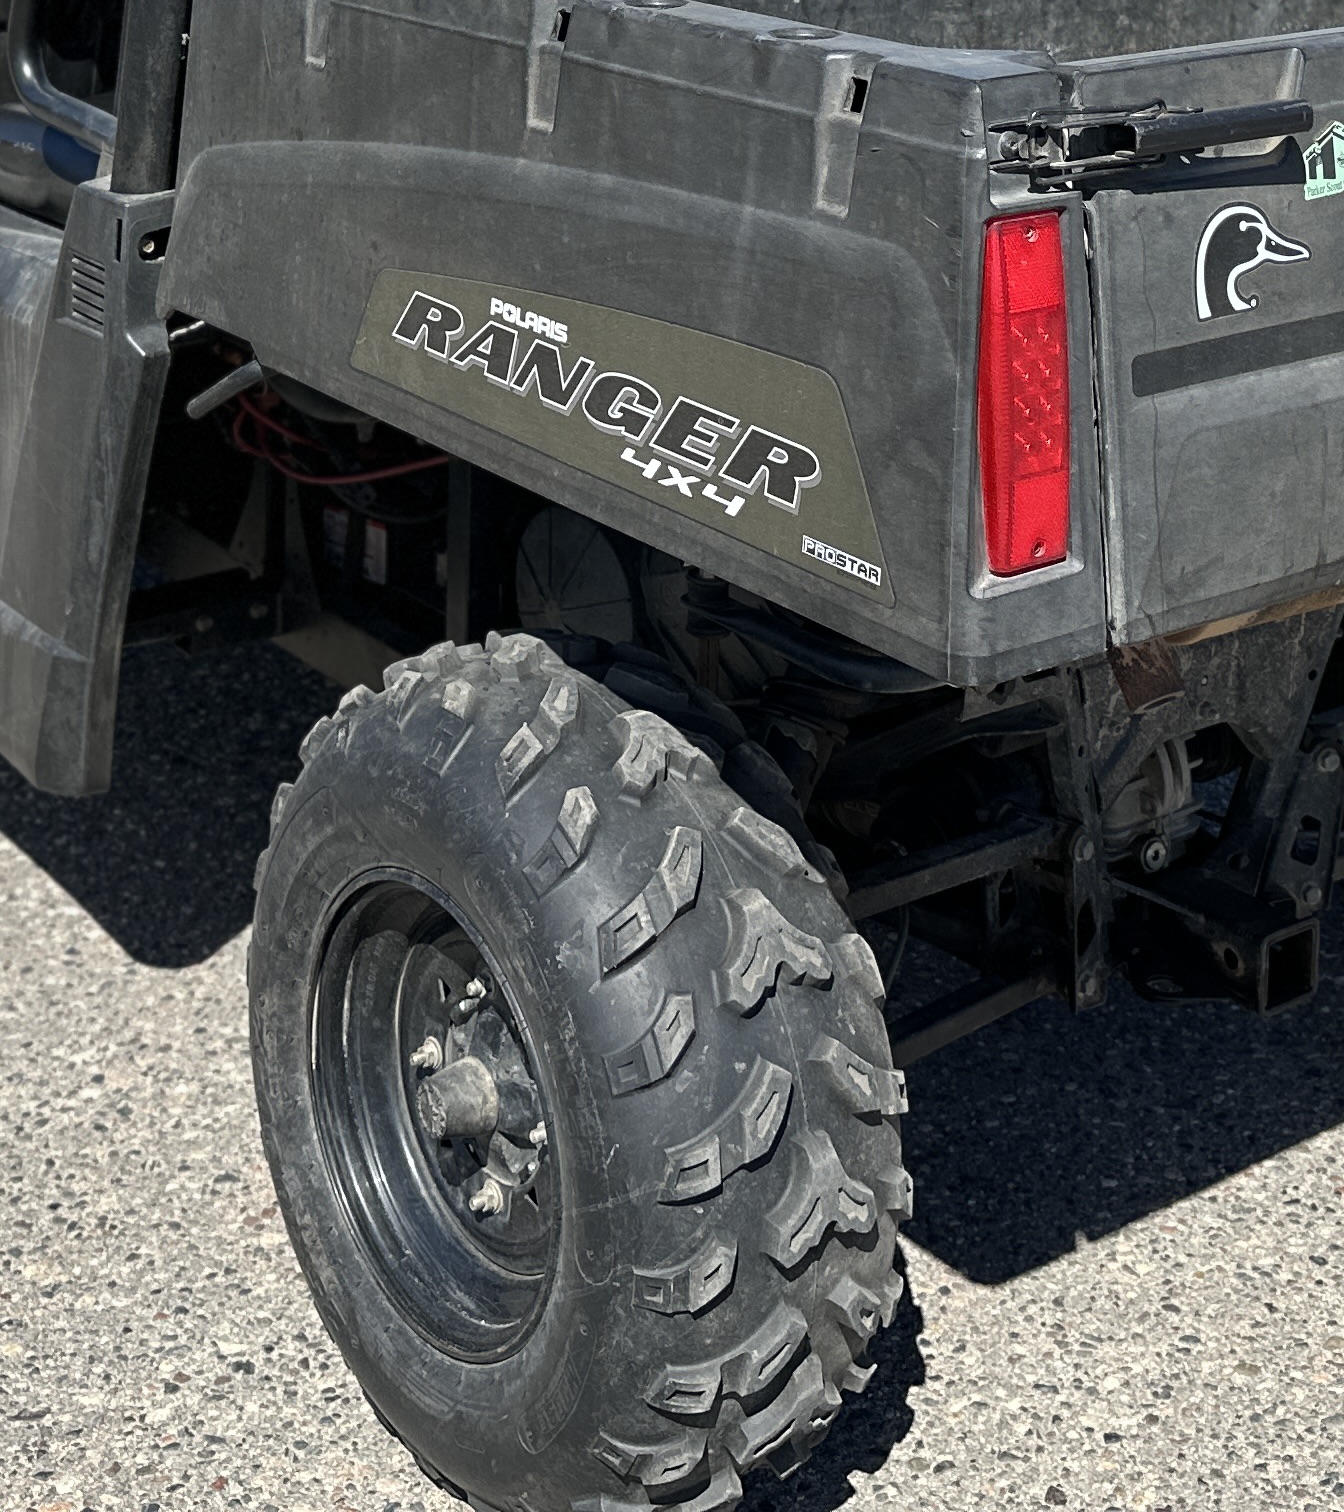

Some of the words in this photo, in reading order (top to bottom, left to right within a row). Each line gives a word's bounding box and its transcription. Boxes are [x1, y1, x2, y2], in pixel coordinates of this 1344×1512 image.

[490, 297, 568, 344] POLARIS
[392, 291, 822, 513] RANGER
[802, 535, 881, 585] PROSTAR
